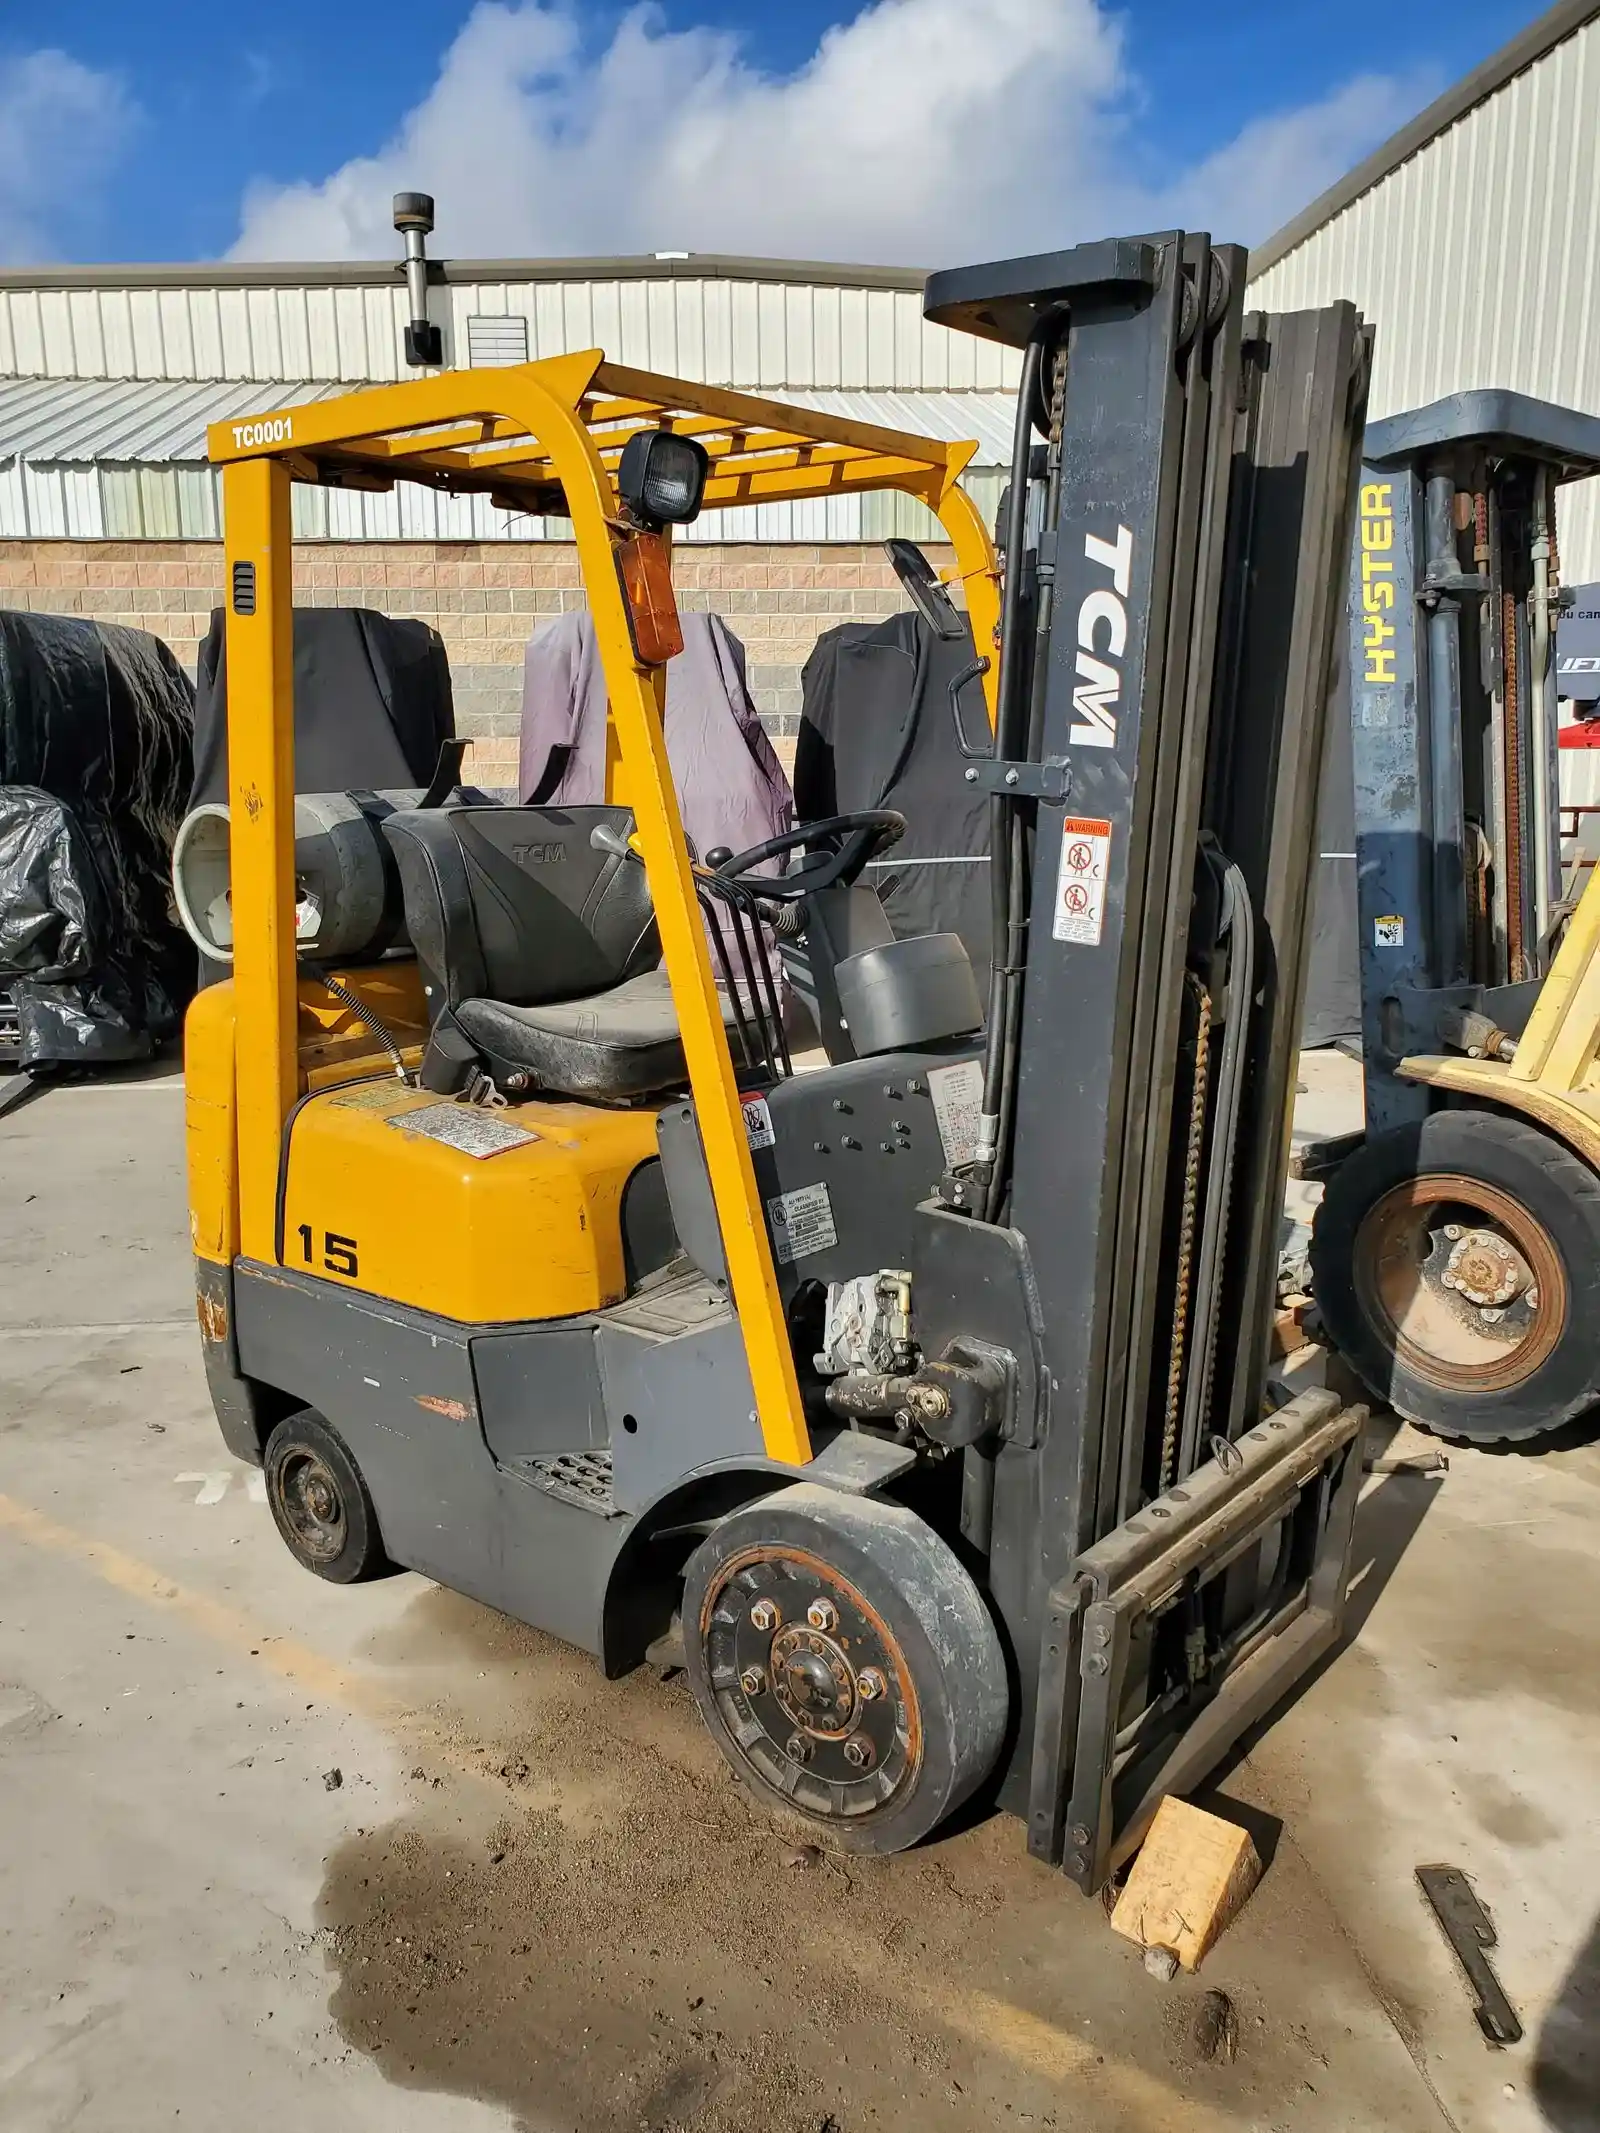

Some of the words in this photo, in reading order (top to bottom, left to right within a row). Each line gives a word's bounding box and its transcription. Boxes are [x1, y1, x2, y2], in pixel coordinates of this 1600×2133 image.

[232, 416, 293, 449] TC0001
[1360, 484, 1396, 683] HYSTER
[1069, 523, 1133, 749] TCM
[1075, 823, 1109, 836] WARNING
[512, 842, 567, 864] TCM
[297, 1224, 358, 1278] 15
